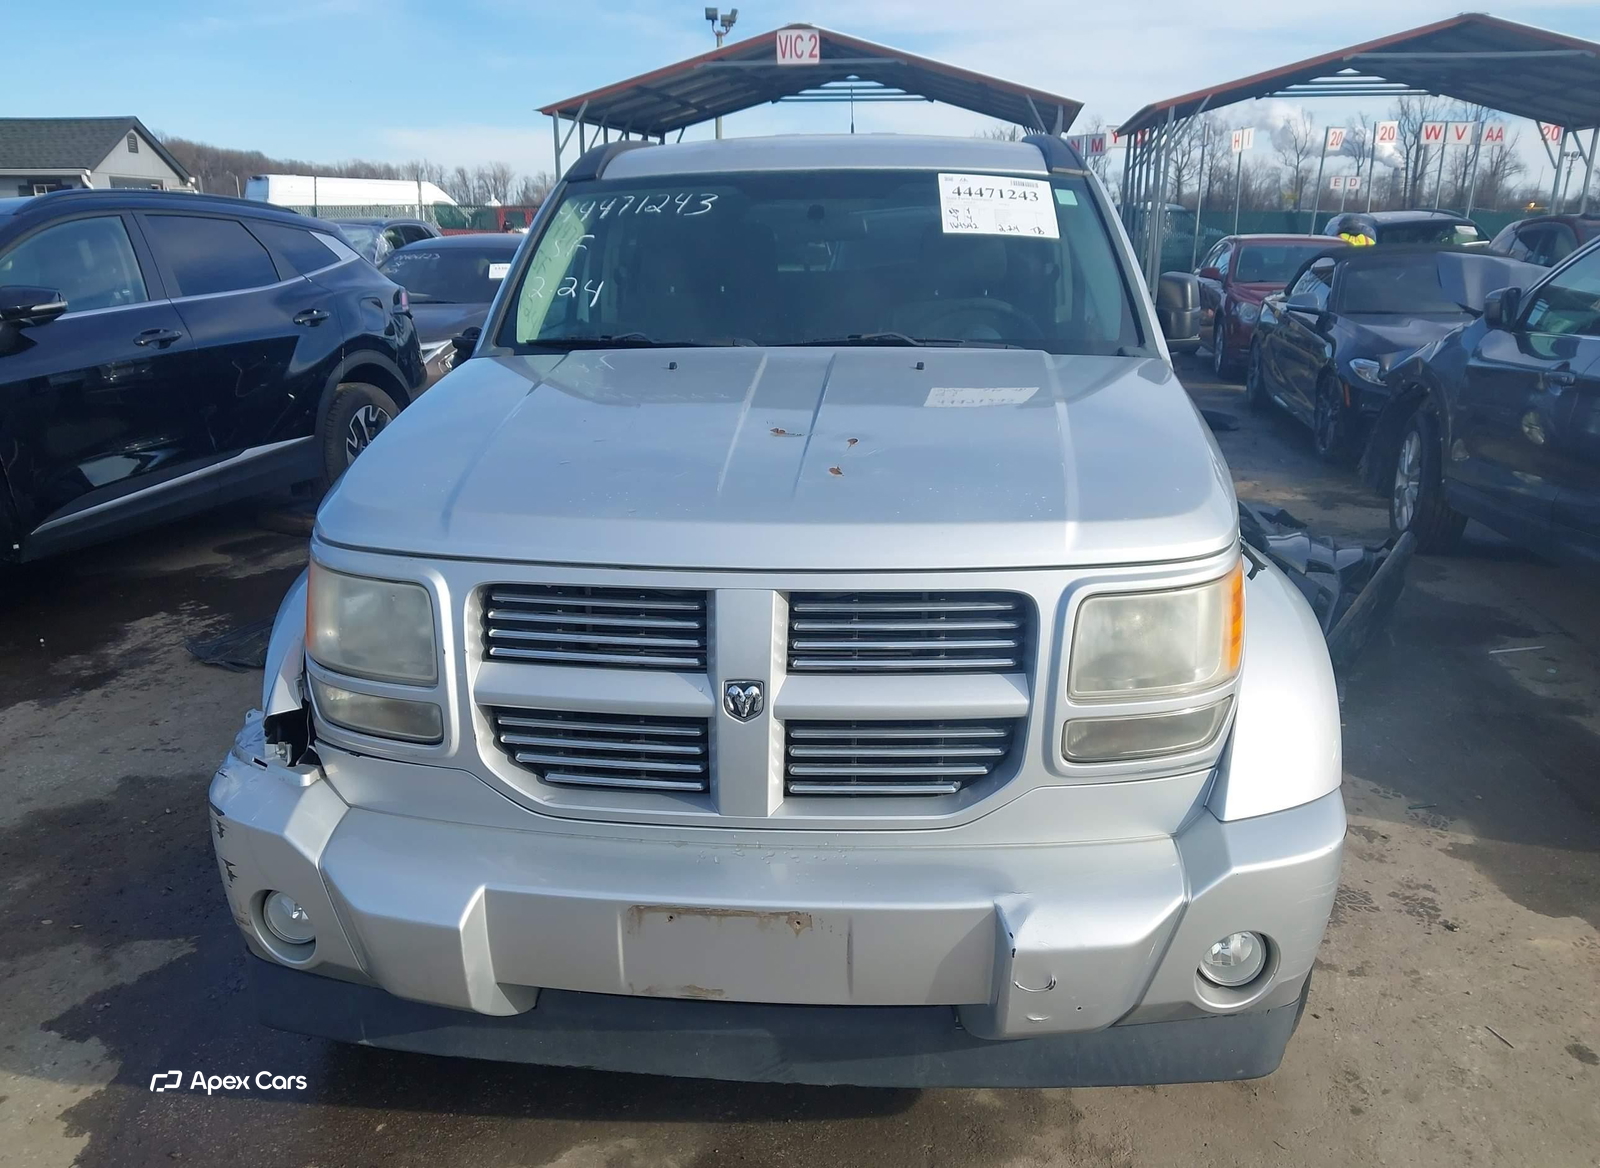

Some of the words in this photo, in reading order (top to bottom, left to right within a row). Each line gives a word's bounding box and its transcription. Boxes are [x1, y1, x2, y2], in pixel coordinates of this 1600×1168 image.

[779, 34, 804, 59] VIC
[808, 33, 818, 59] 2
[1330, 131, 1343, 147] 20
[1380, 125, 1396, 141] 20
[1425, 125, 1444, 140] W
[1455, 125, 1468, 140] V
[1485, 126, 1504, 142] AA
[1541, 125, 1560, 141] 20
[1091, 138, 1103, 153] M
[1234, 133, 1240, 150] H
[1334, 178, 1340, 187] E
[1349, 178, 1357, 187] D
[951, 185, 1039, 202] 44471243
[559, 192, 719, 222] 44471243
